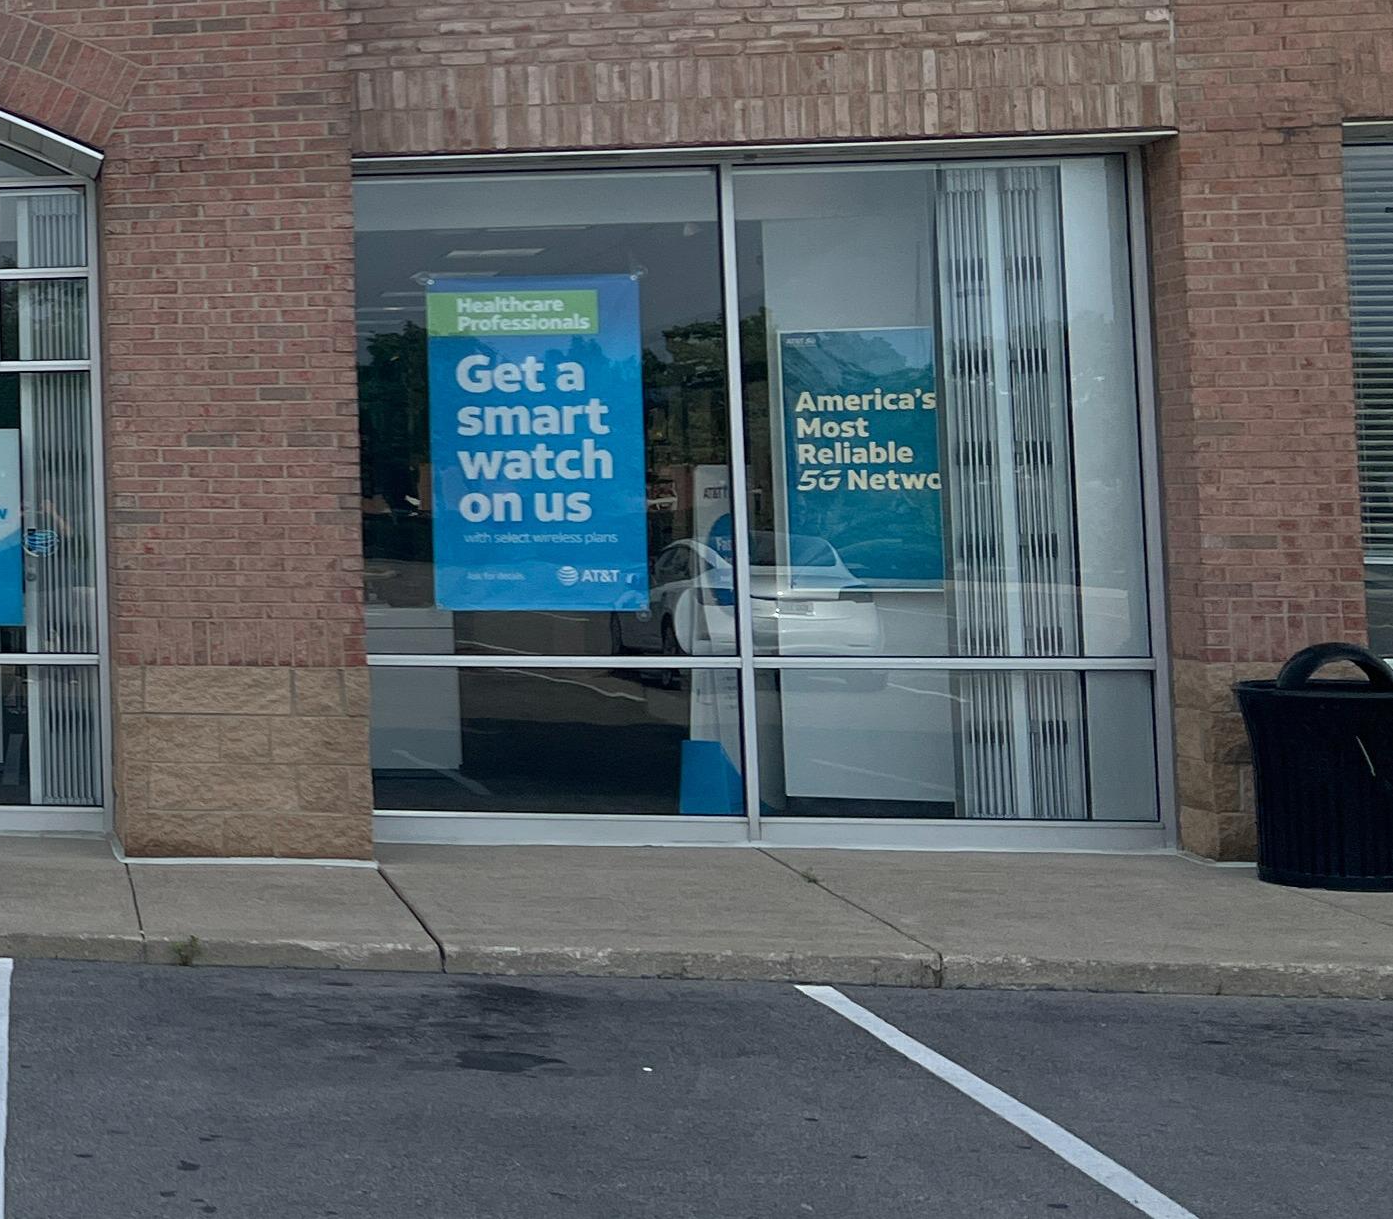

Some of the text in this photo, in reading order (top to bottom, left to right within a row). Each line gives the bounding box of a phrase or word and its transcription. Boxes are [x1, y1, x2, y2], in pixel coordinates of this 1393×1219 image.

[457, 296, 565, 313] Healthcare
[457, 313, 591, 331] Professionals
[456, 354, 585, 393] Get a
[795, 387, 937, 412] America's
[457, 398, 611, 436] smart
[796, 417, 870, 439] Most
[457, 438, 614, 480] watch
[797, 440, 914, 465] Reliable
[796, 469, 842, 491] 5G
[459, 491, 593, 523] on us
[464, 532, 619, 545] with select wireless plans
[581, 569, 620, 583] AT&T
